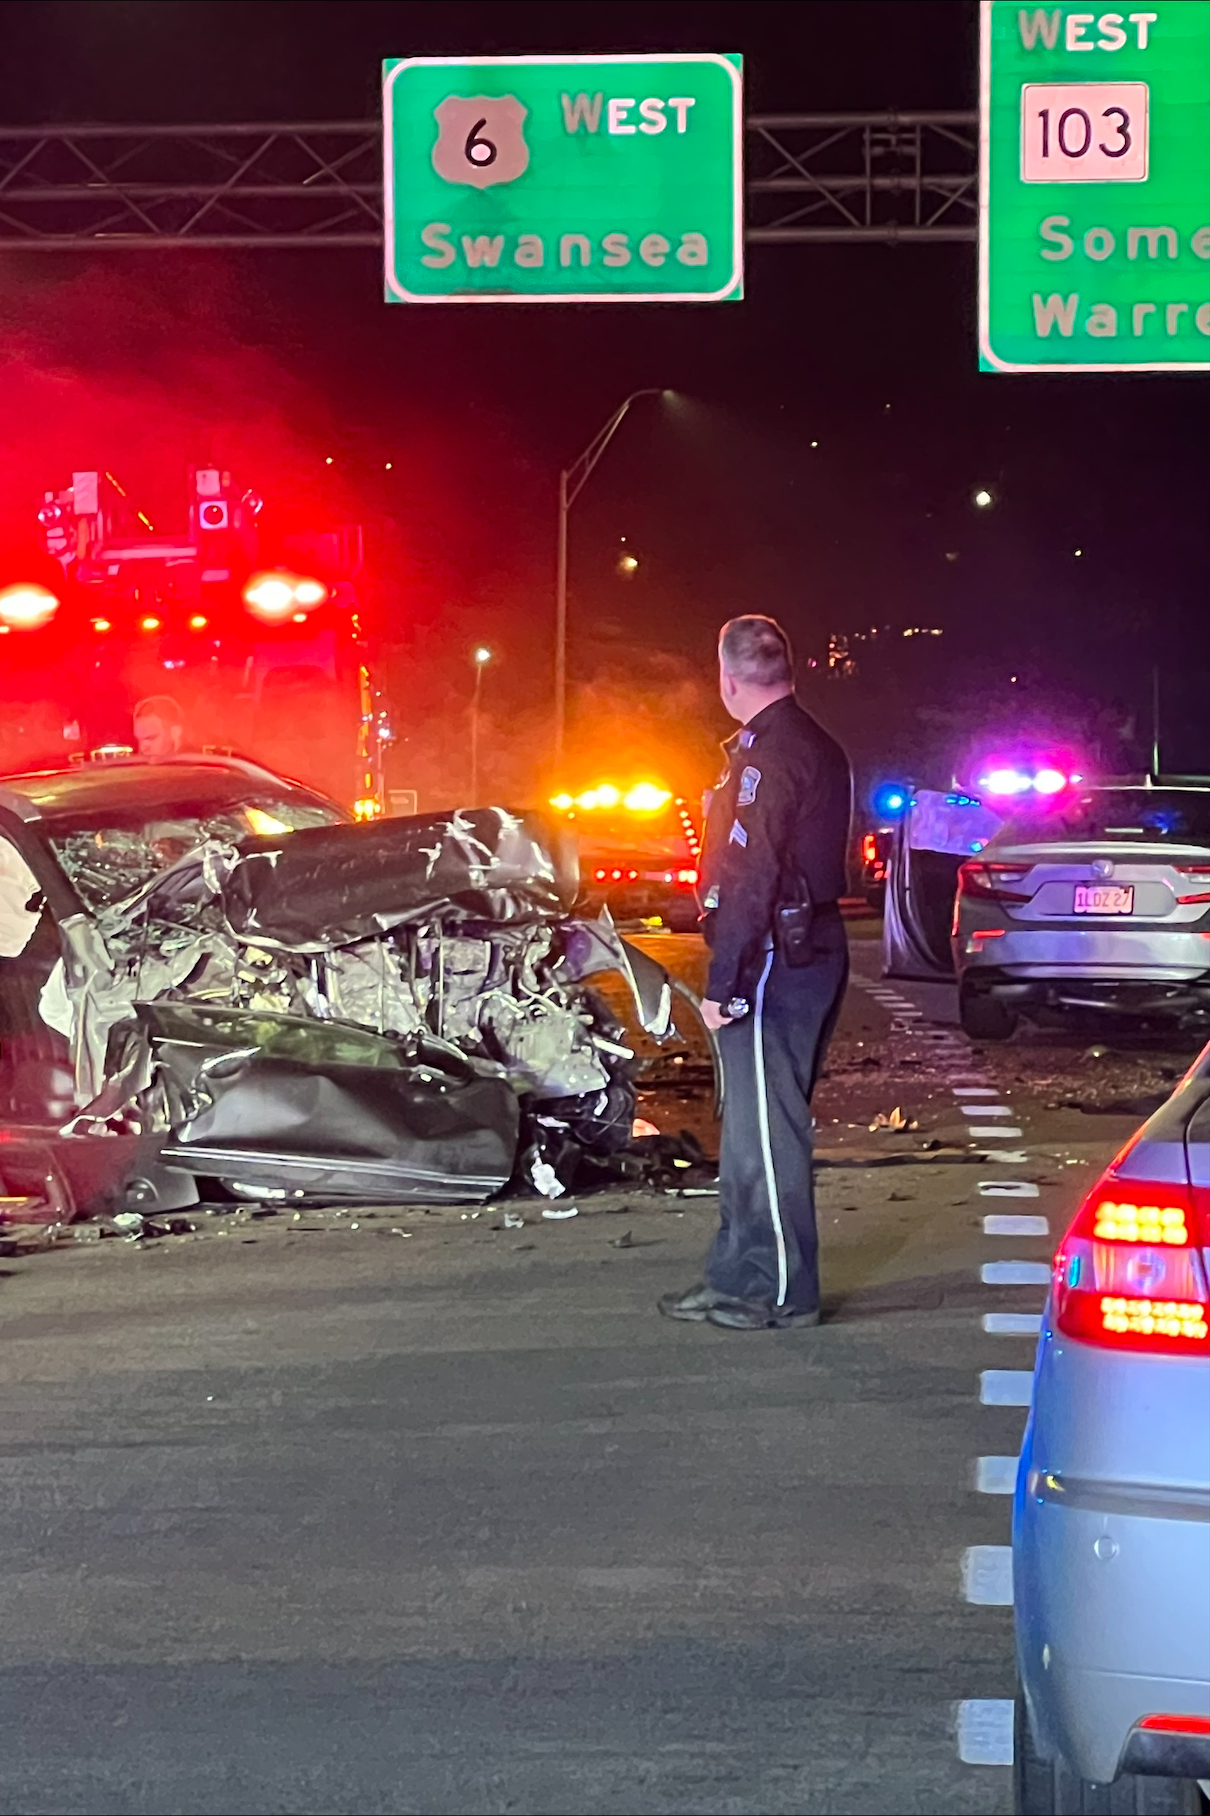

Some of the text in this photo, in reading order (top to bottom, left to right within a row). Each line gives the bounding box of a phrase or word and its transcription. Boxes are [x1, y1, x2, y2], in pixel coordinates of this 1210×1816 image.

[1018, 8, 1157, 51] WEST
[464, 92, 696, 167] 6 WEST
[1038, 106, 1132, 158] 103
[421, 222, 709, 268] Swansea
